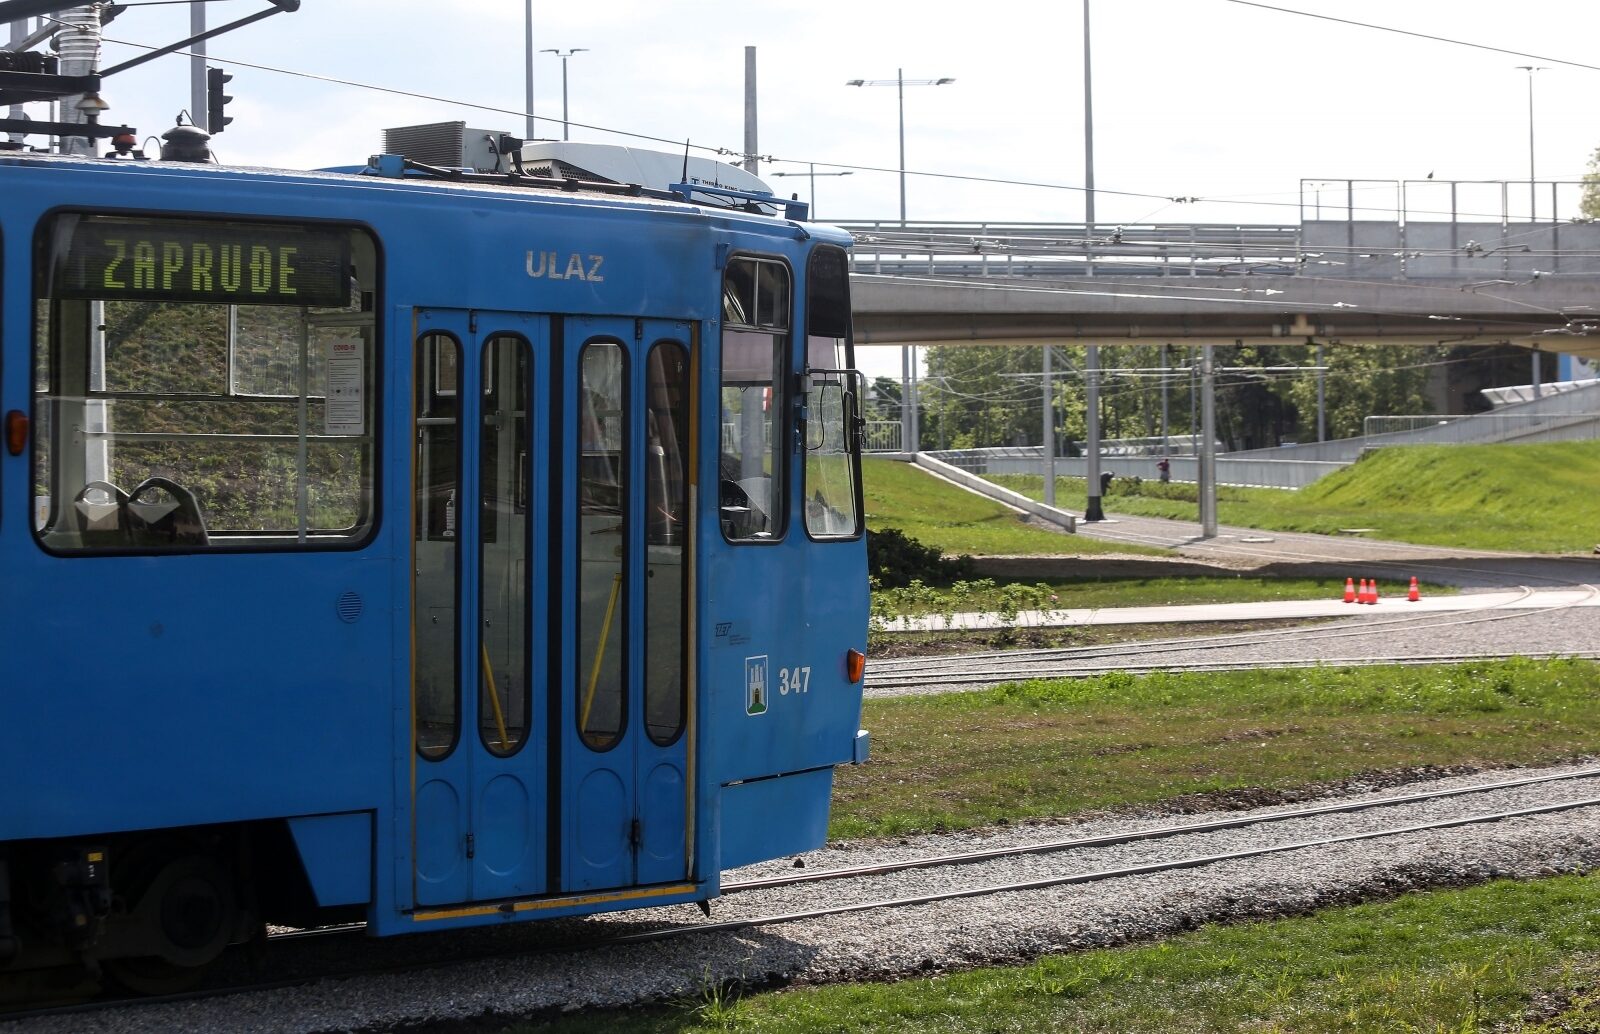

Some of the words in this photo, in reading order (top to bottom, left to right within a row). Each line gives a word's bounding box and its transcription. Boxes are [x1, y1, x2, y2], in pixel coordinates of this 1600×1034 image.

[702, 180, 723, 188] THERO
[104, 239, 297, 294] ZAPRUĐE
[526, 250, 604, 282] ULAZ
[779, 667, 811, 696] 347
